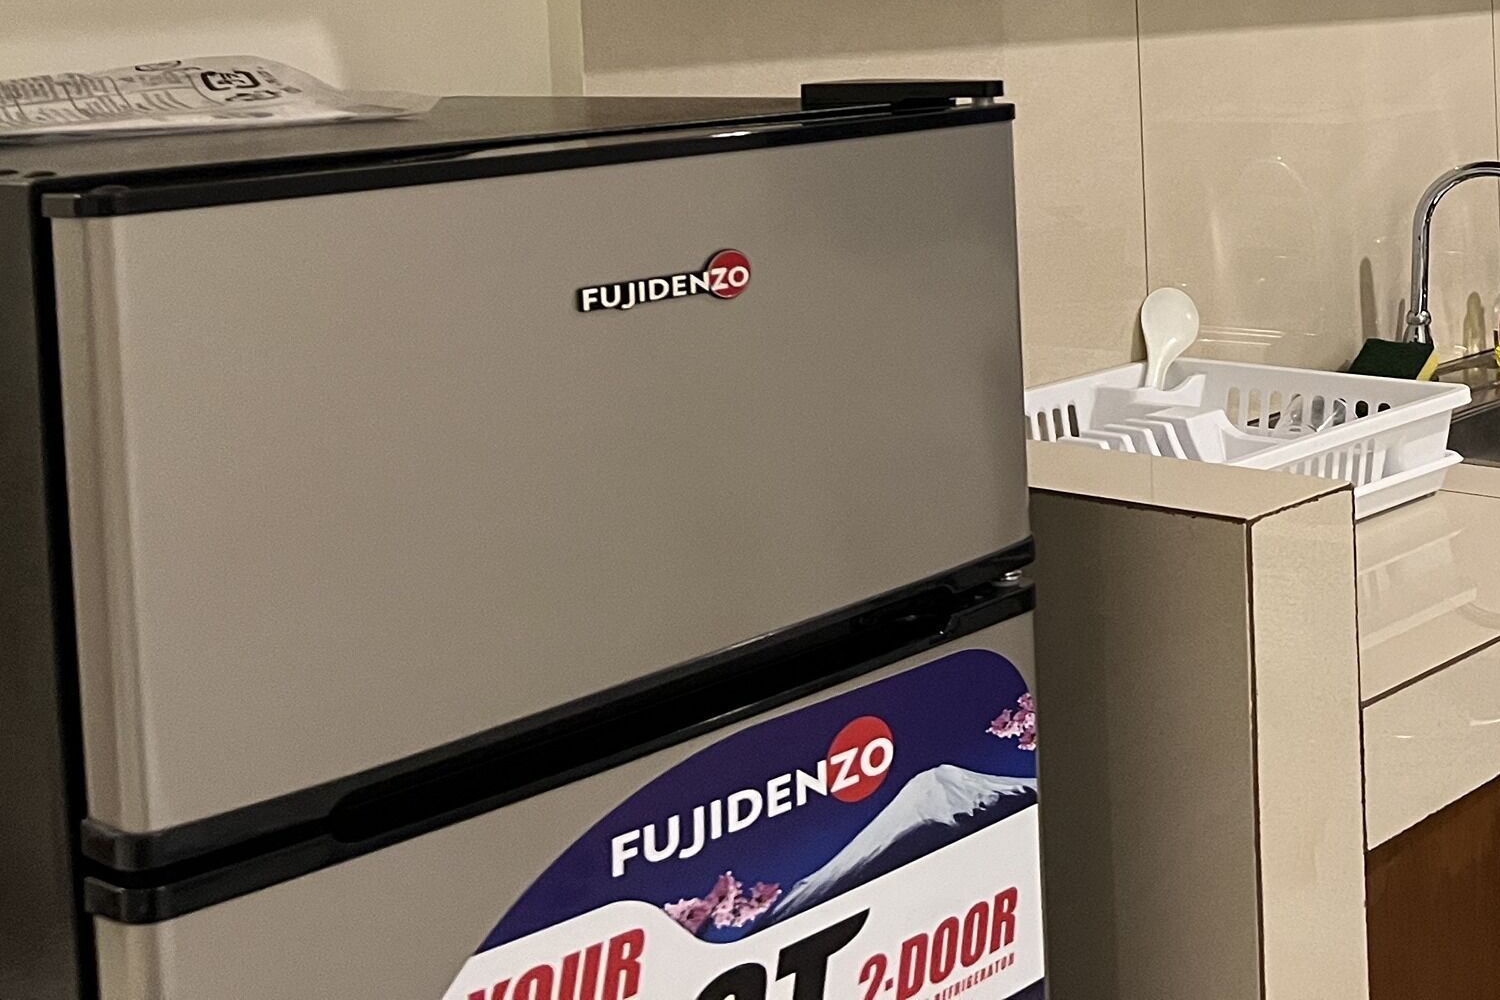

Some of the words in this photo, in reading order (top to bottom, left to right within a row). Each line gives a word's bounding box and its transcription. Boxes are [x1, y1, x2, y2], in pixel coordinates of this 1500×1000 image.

[582, 265, 750, 311] FUJIDENZO
[612, 737, 894, 878] FUJIDENZO
[858, 886, 1018, 1000] 2-DOOR
